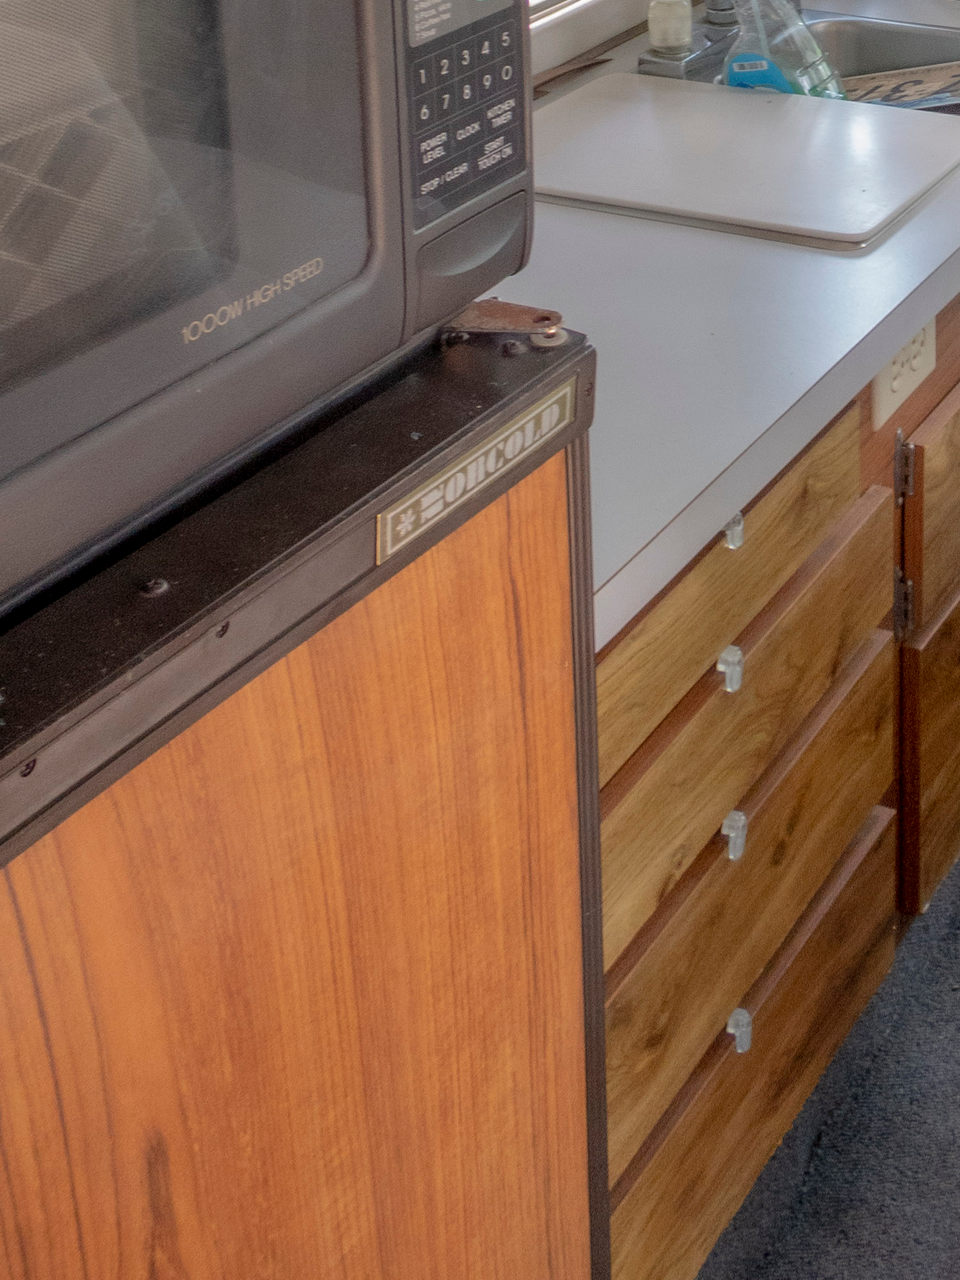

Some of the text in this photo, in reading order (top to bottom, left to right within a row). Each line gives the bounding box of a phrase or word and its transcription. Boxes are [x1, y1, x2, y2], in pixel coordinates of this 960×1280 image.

[419, 32, 510, 84] 1 2 3 4 5
[420, 65, 513, 120] 6 7 8 9 0
[419, 132, 448, 153] POWER
[456, 122, 481, 141] CLOCK
[422, 146, 447, 164] LEVEL
[420, 177, 441, 196] STOP
[445, 162, 469, 183] CLEAR
[181, 257, 324, 344] 1000W HIGH SPEED
